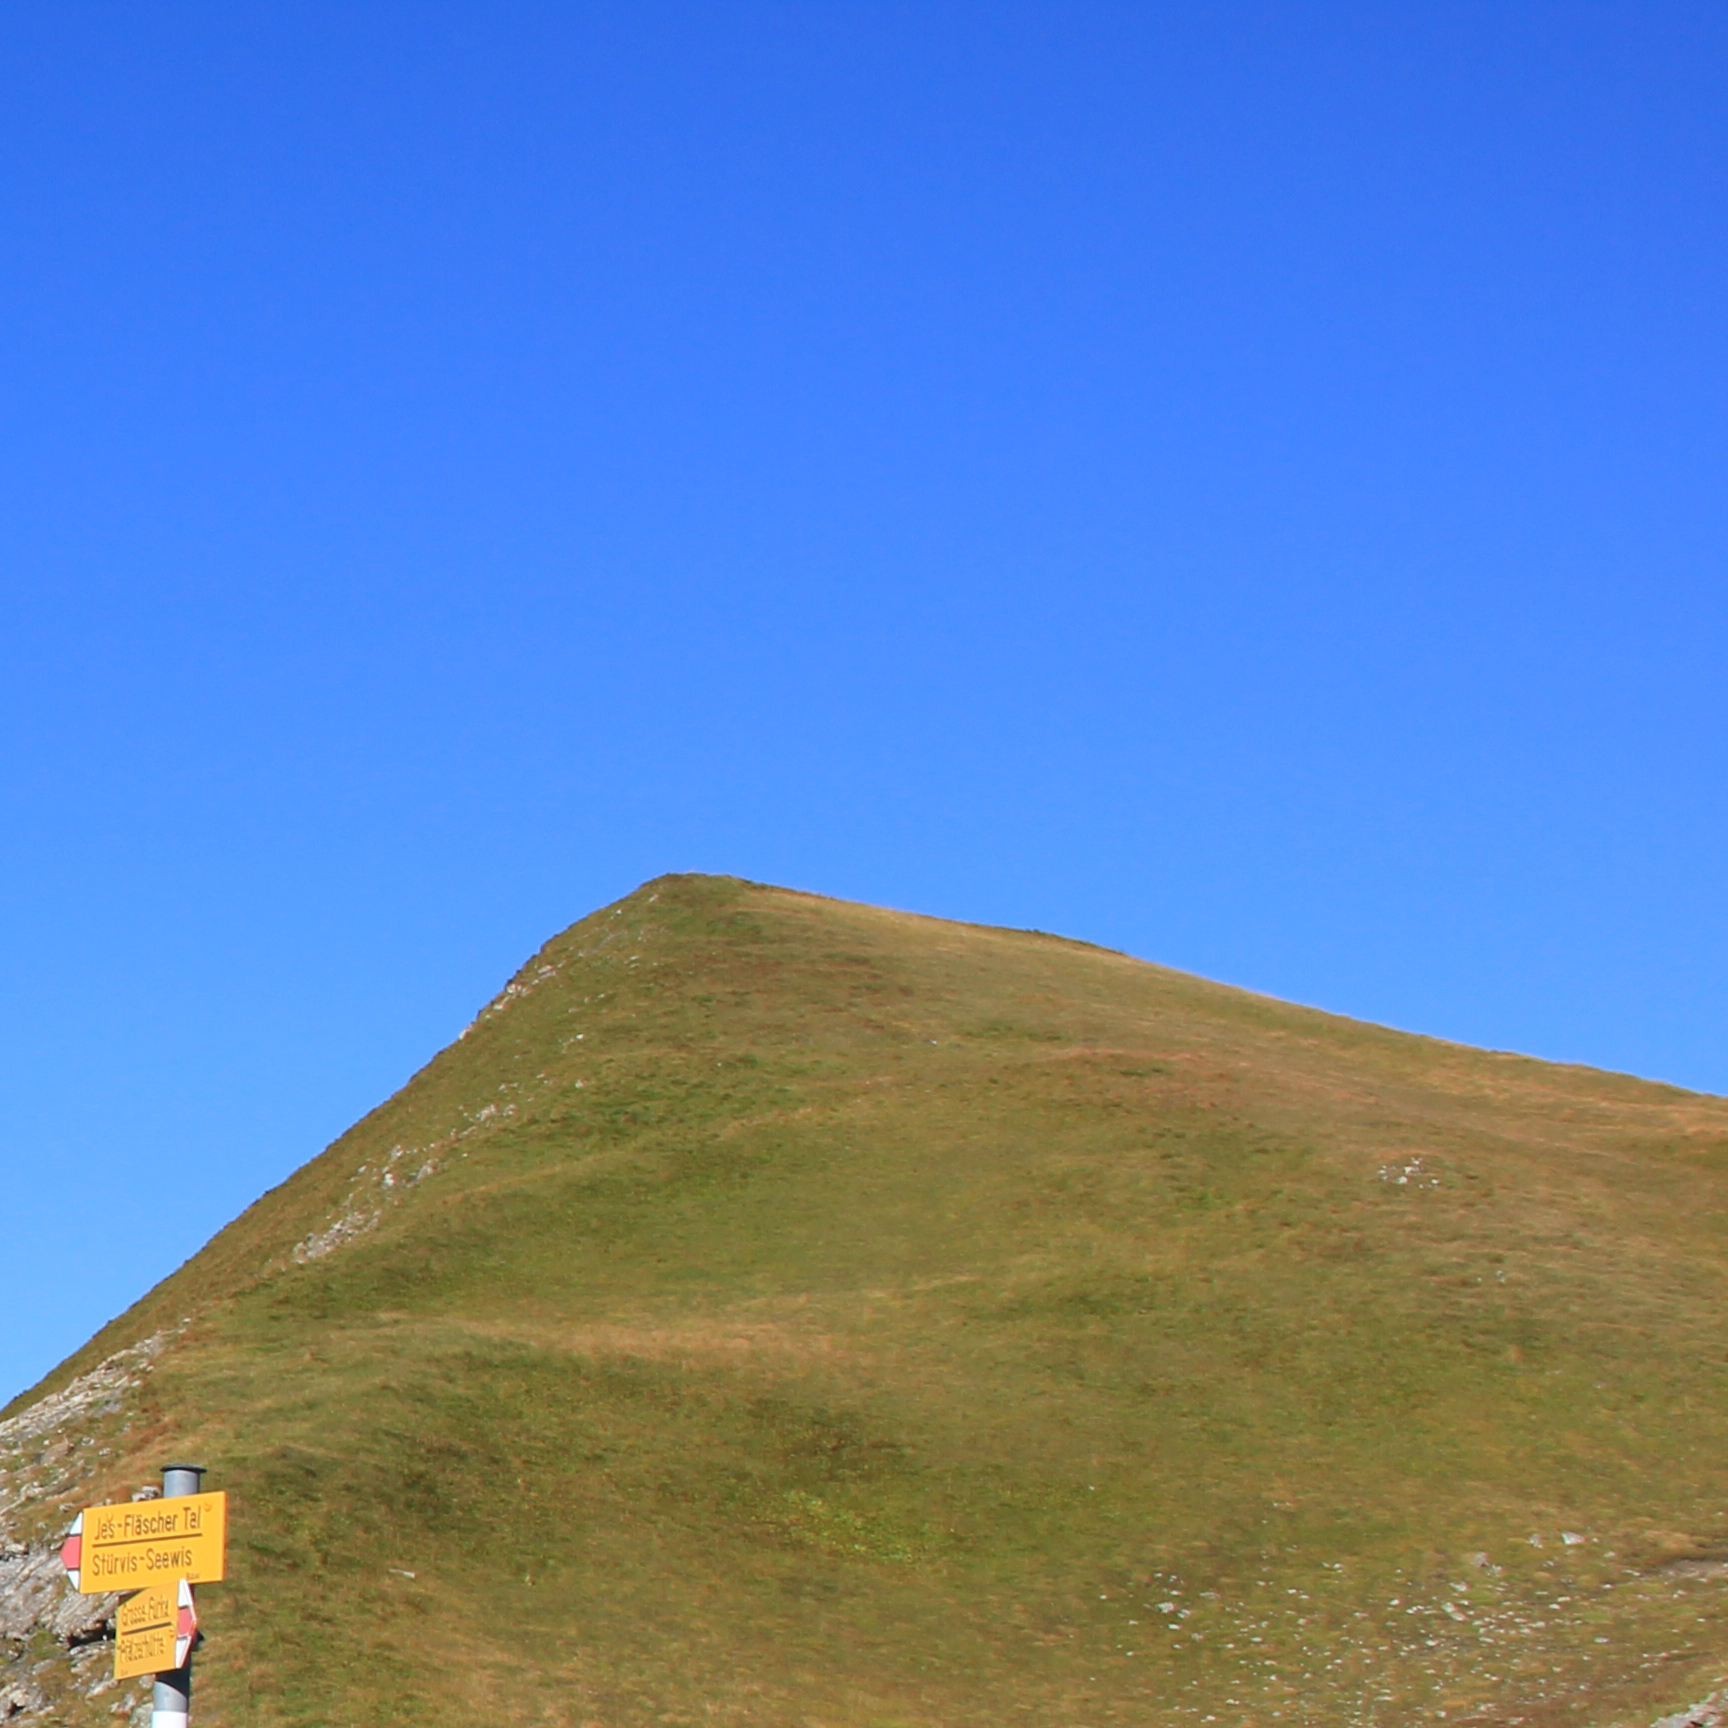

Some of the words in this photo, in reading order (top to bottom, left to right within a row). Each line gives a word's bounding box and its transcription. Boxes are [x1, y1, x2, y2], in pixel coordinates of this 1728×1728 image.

[94, 1510, 178, 1541] Jes-Fläscher
[182, 1504, 202, 1531] Tal
[92, 1546, 193, 1576] Stürvis-Seewis
